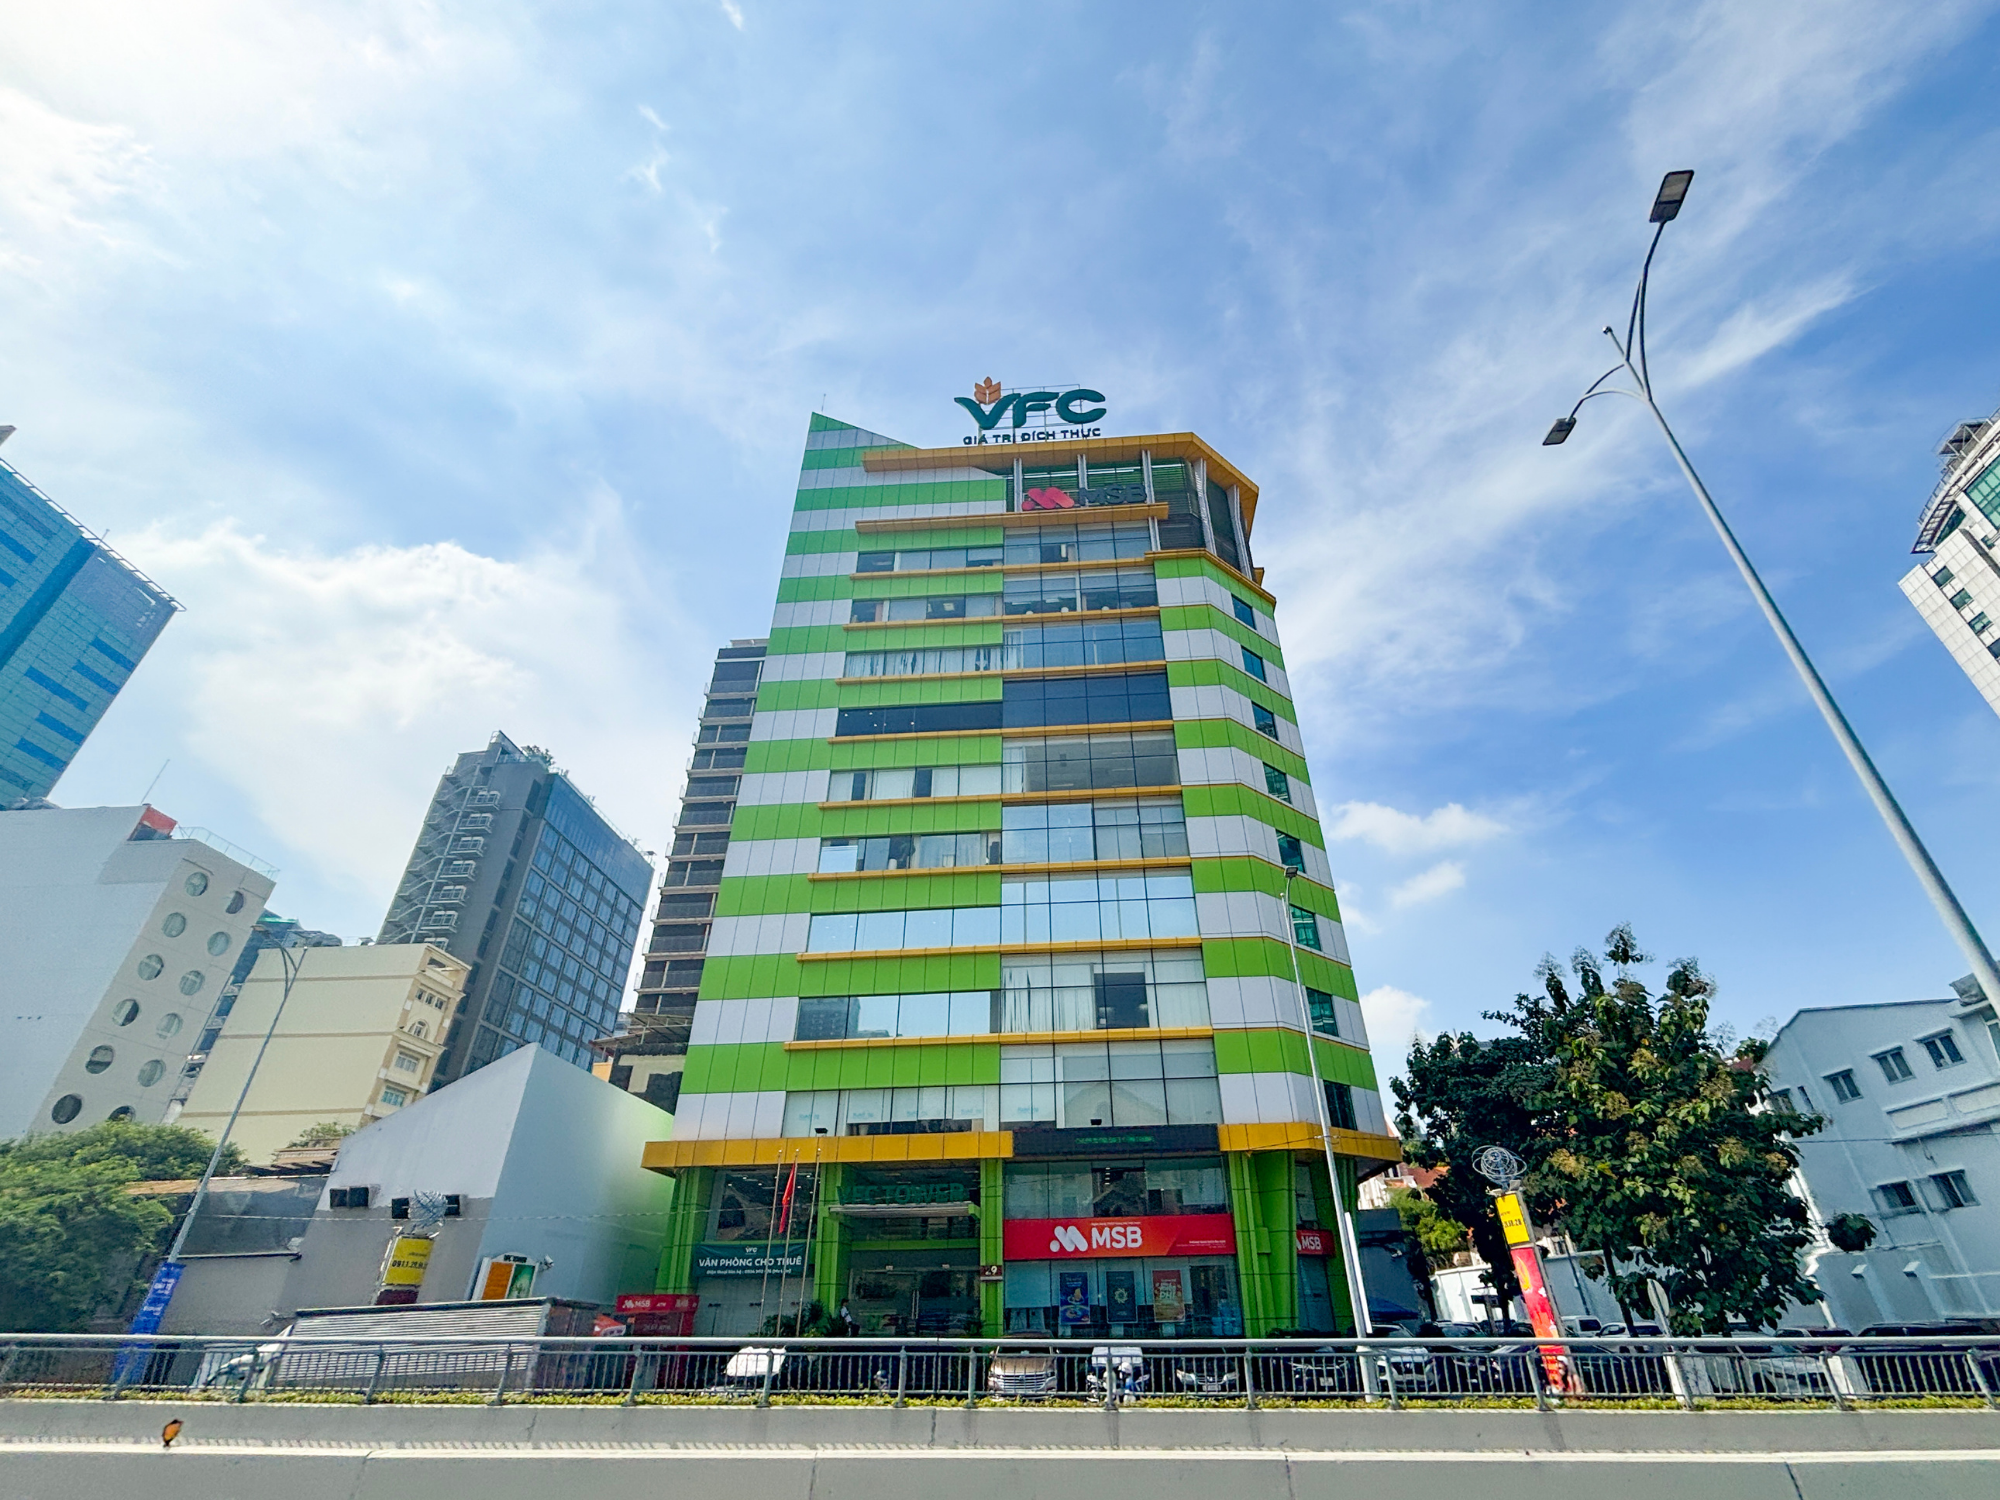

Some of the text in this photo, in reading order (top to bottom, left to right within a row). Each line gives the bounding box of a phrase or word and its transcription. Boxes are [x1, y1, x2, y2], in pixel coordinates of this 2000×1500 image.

[954, 389, 1107, 430] VFC
[963, 434, 988, 445] GIÁ
[1021, 430, 1055, 442] ĐÍCH
[1078, 483, 1147, 506] MSB
[881, 1183, 965, 1204] TOWER
[1091, 1226, 1143, 1249] MSB
[1301, 1235, 1322, 1250] MSB
[698, 1256, 719, 1267] VĂN
[719, 1256, 753, 1267] PHÒNG
[754, 1257, 774, 1267] CHO
